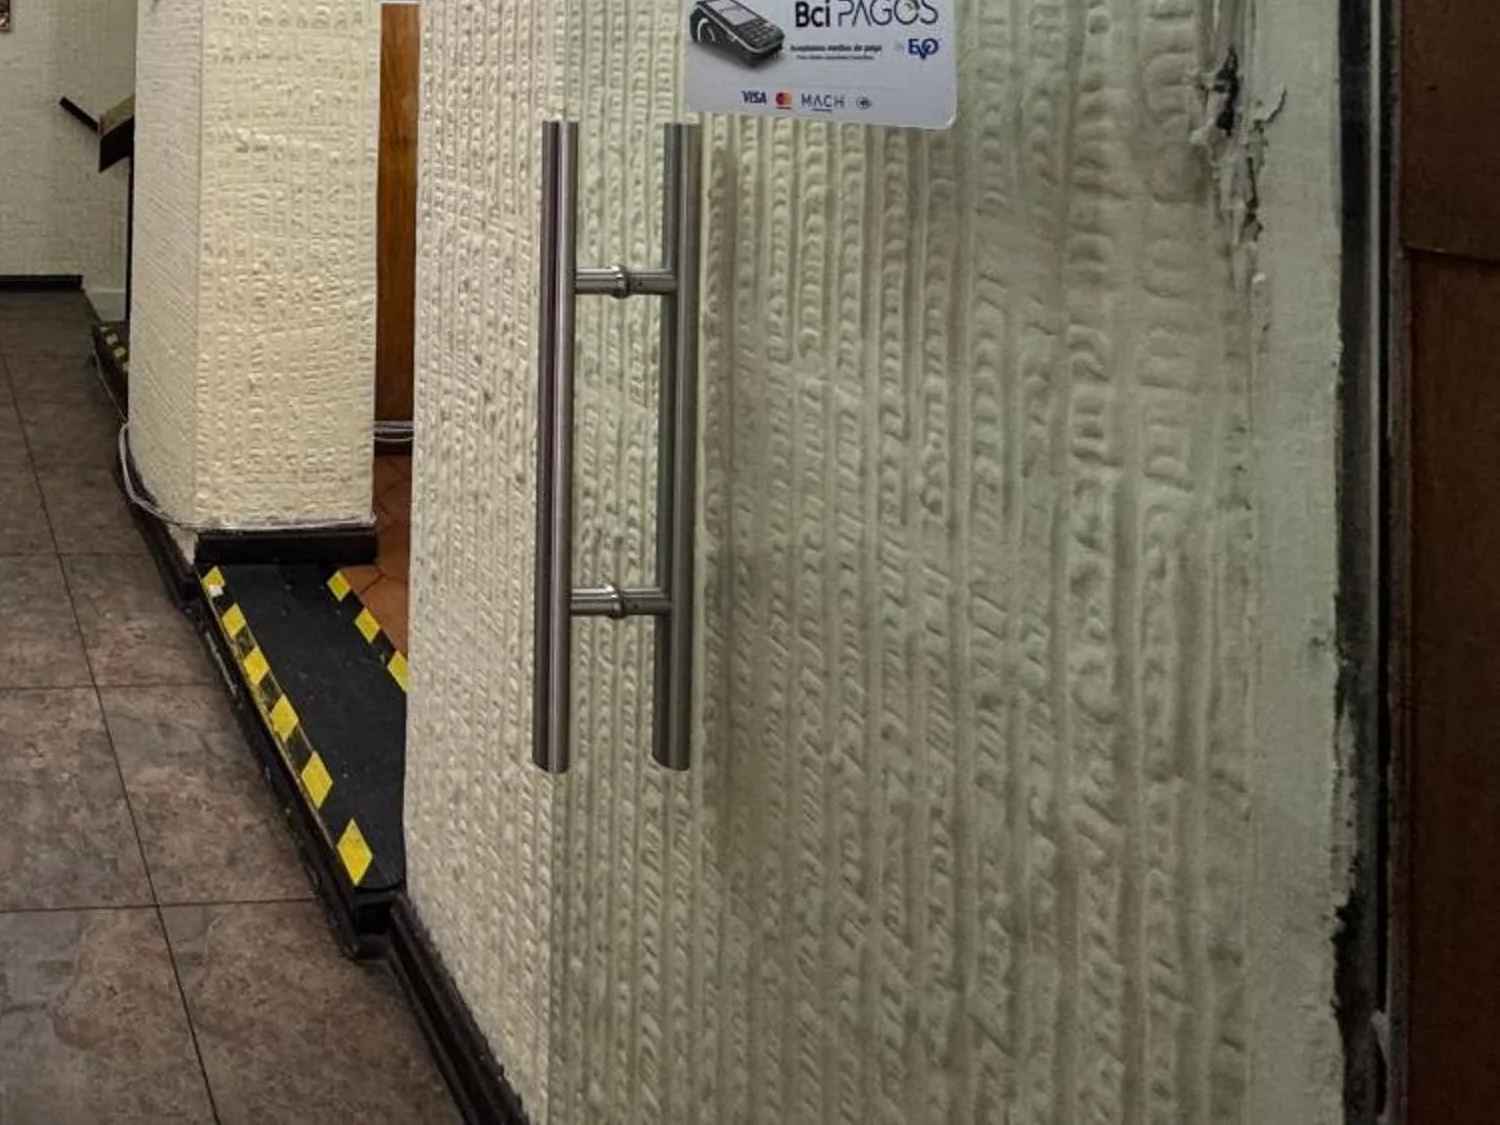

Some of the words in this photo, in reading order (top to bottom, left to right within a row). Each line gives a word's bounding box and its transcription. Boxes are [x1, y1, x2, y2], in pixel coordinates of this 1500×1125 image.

[907, 37, 940, 60] EVO
[740, 90, 768, 105] VISA
[800, 93, 845, 108] MACH
